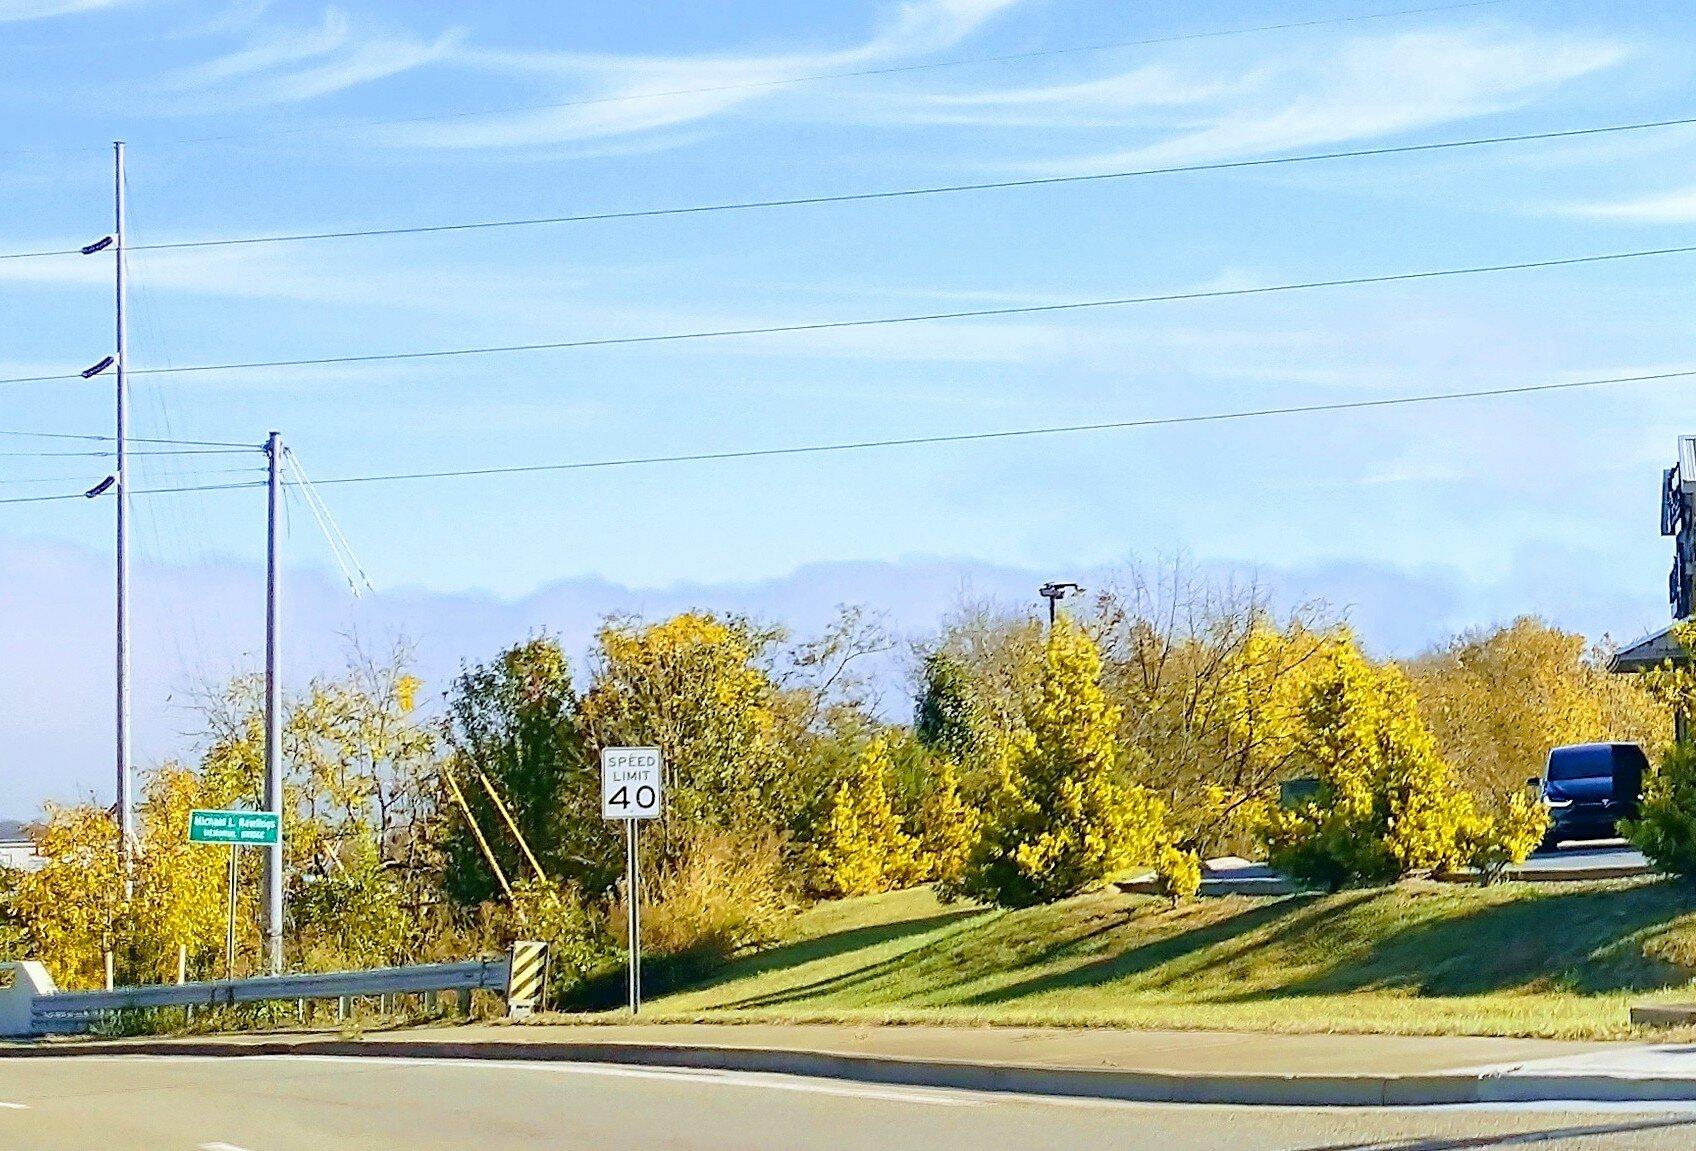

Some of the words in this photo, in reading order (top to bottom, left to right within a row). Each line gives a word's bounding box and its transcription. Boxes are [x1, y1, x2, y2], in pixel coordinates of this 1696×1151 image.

[608, 756, 656, 767] SPEED
[613, 770, 651, 781] LIMIT
[608, 785, 656, 809] 40
